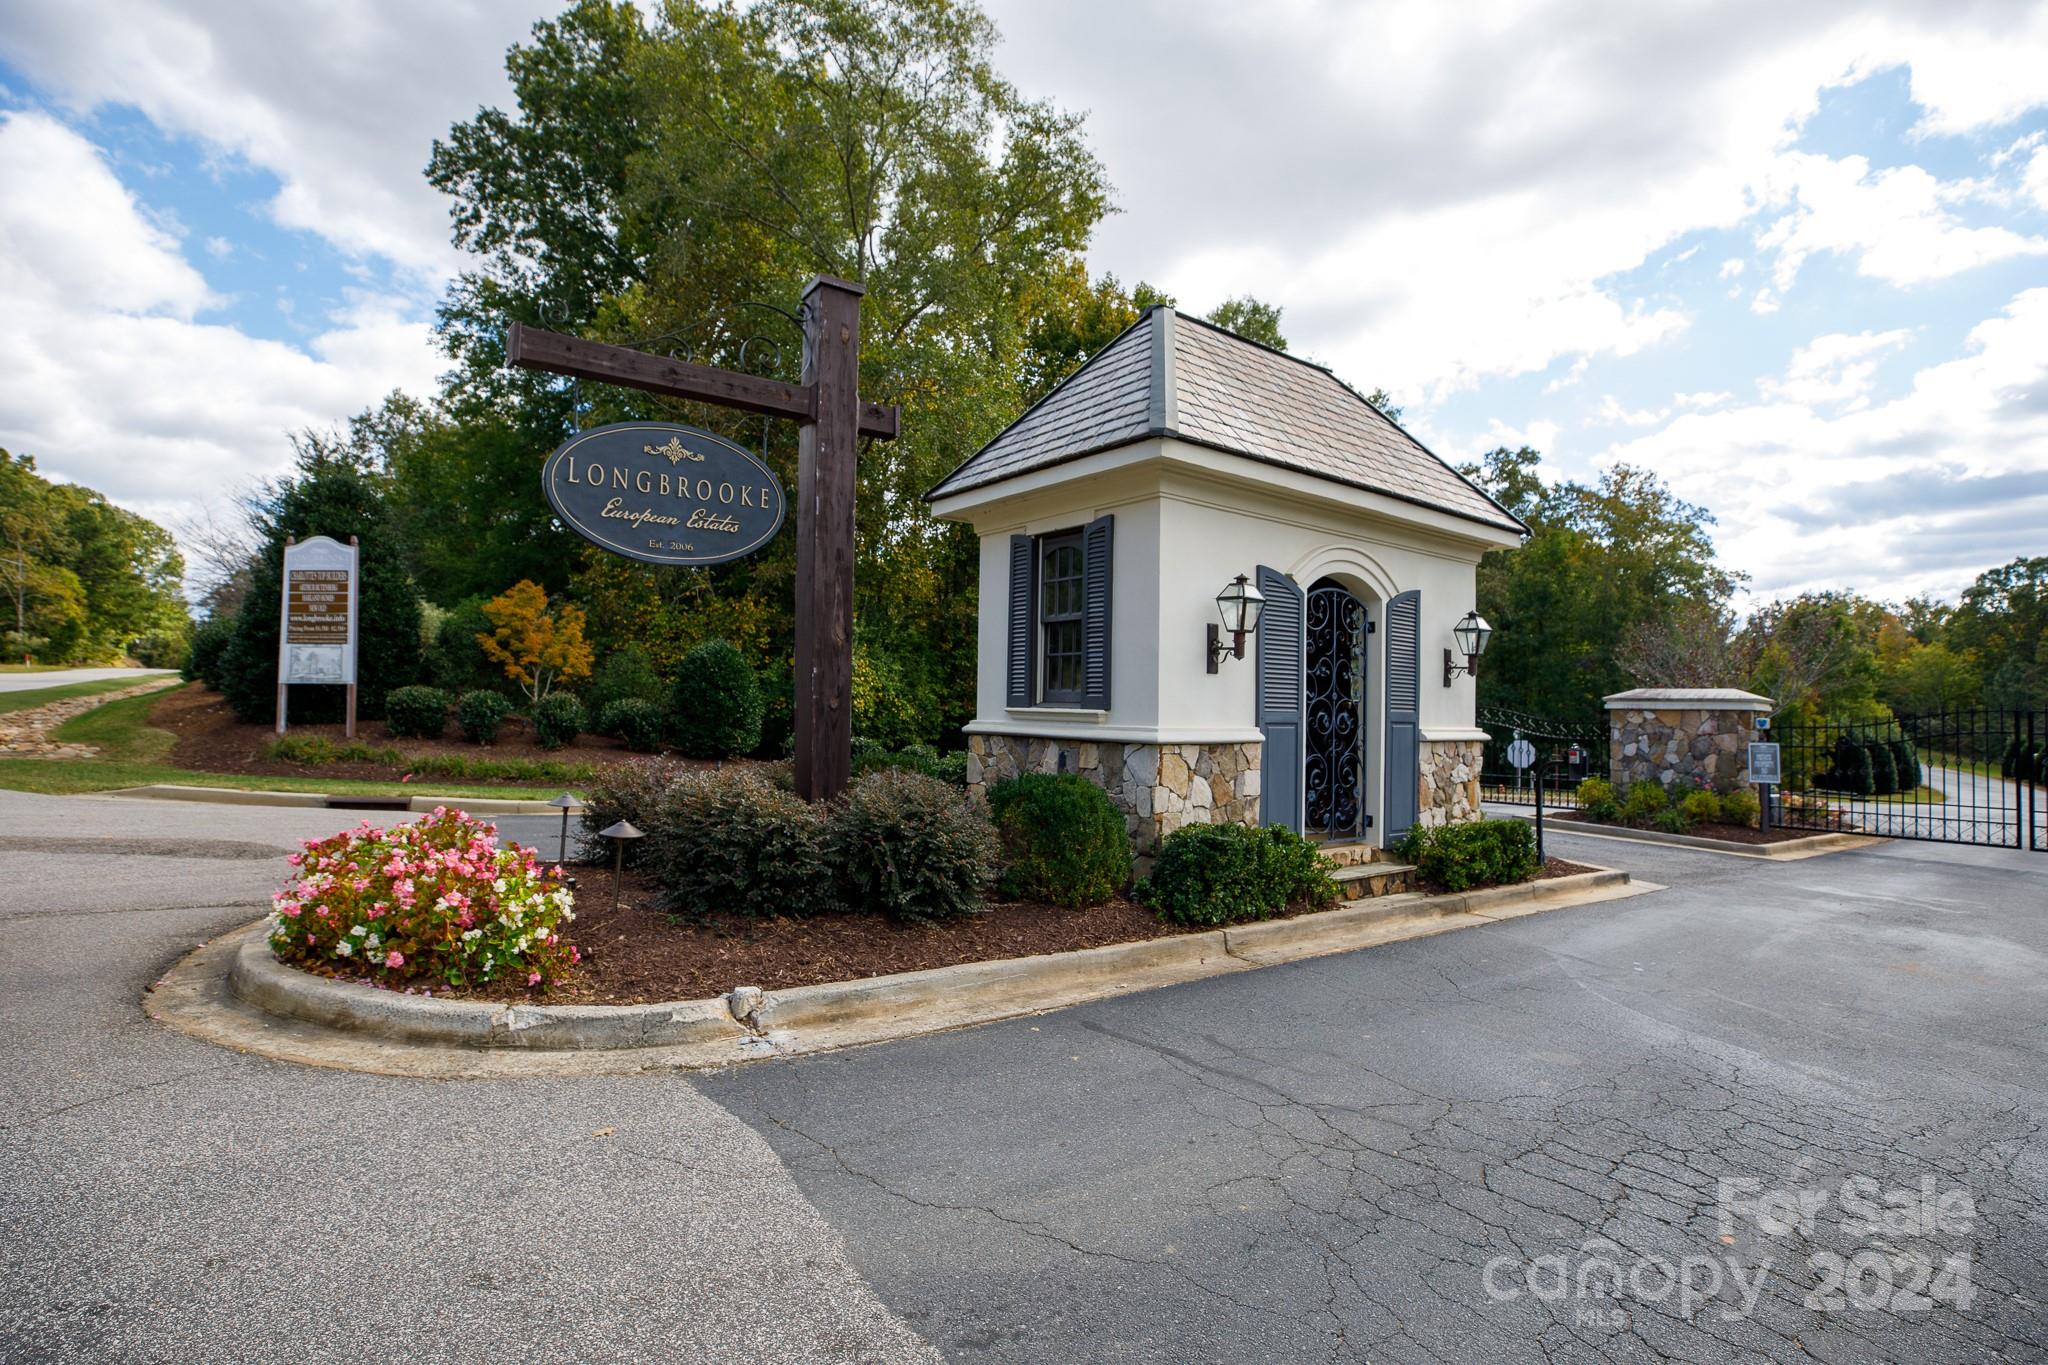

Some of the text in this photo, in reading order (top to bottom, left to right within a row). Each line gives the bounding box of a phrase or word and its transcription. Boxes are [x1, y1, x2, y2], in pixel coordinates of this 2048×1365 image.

[567, 456, 770, 509] LONGBROOKE
[600, 497, 740, 534] European Estates
[648, 539, 694, 551] Est. 2006
